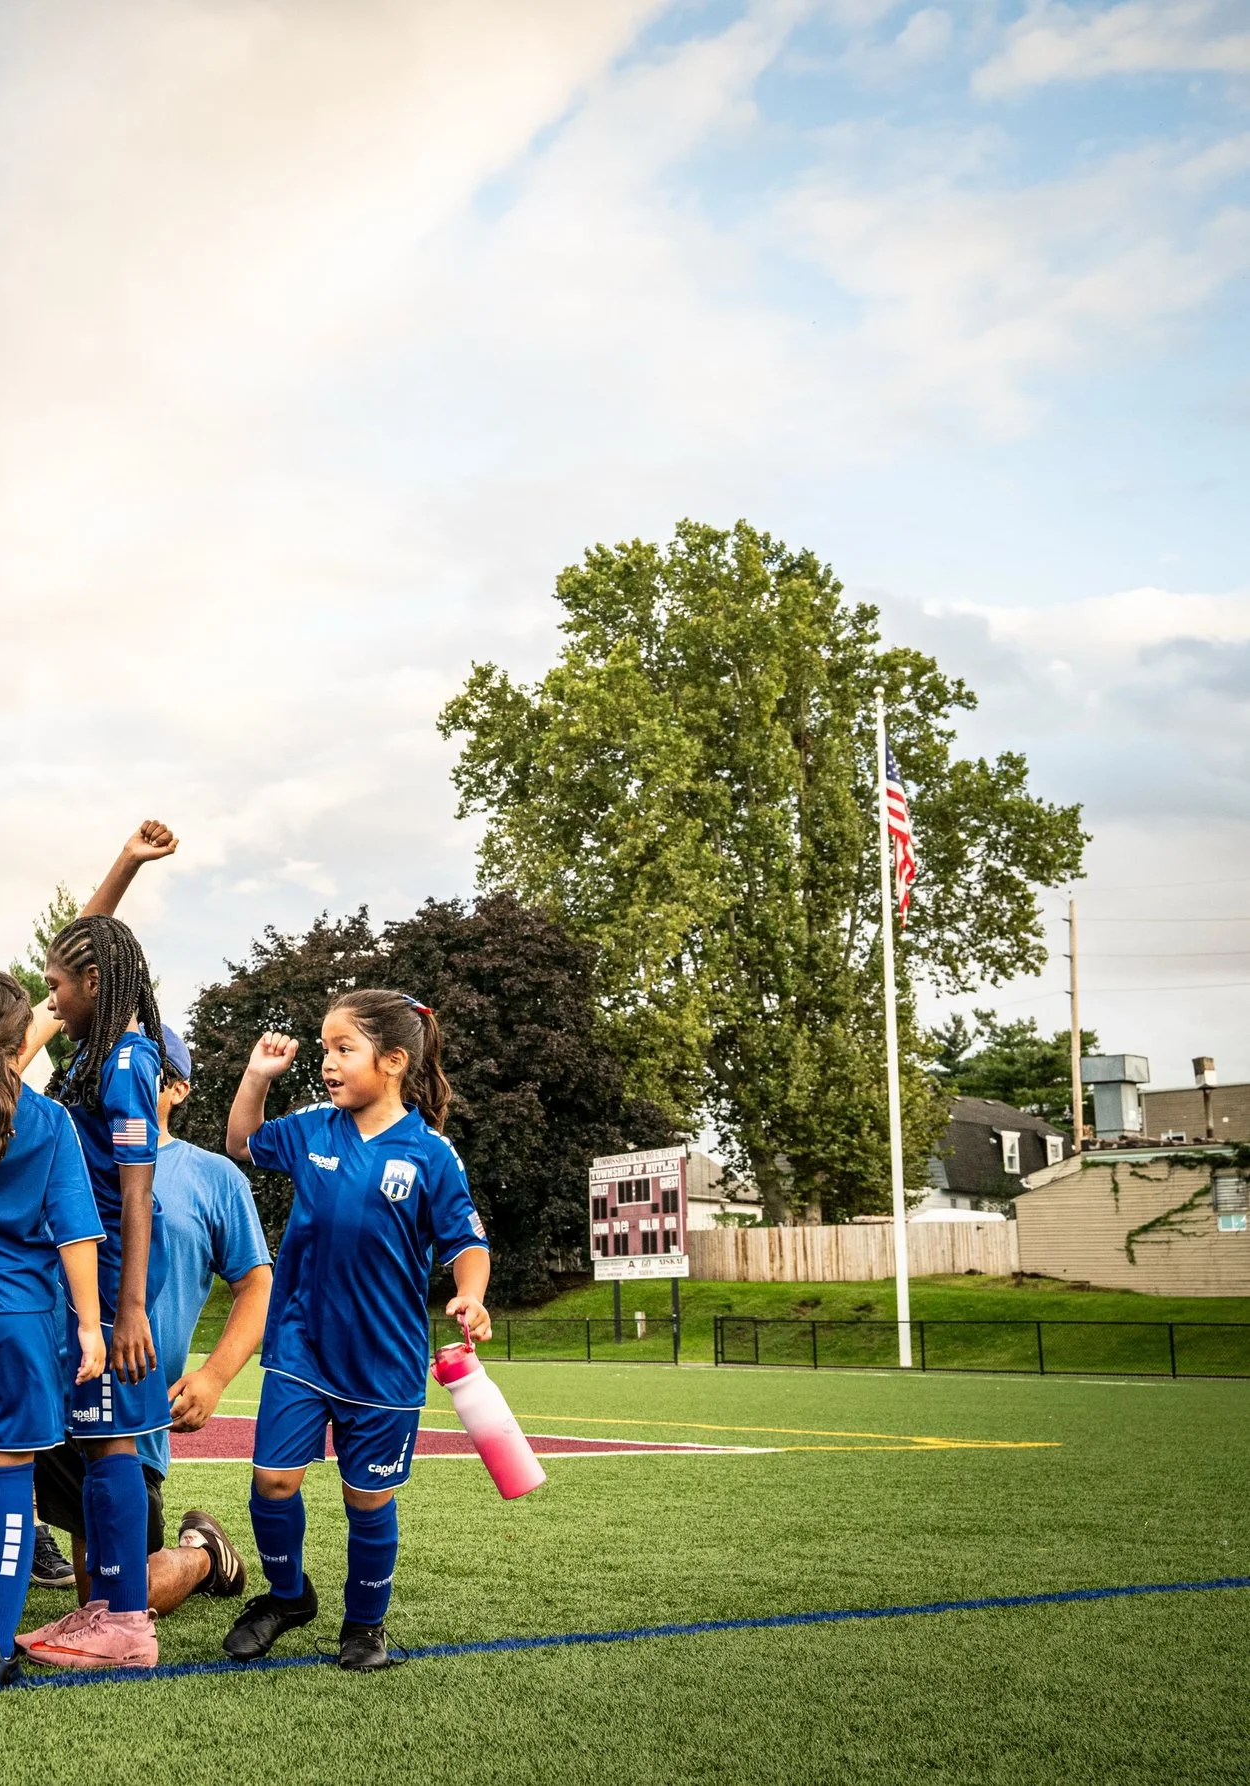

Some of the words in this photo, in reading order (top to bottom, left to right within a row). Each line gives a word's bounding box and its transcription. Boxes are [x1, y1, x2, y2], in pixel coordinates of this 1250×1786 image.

[591, 1166, 632, 1180] TOWNSHIP
[633, 1163, 644, 1175] OF
[646, 1160, 679, 1173] NUTLEY
[659, 1176, 679, 1189] GUEST
[72, 1406, 99, 1421] apelli
